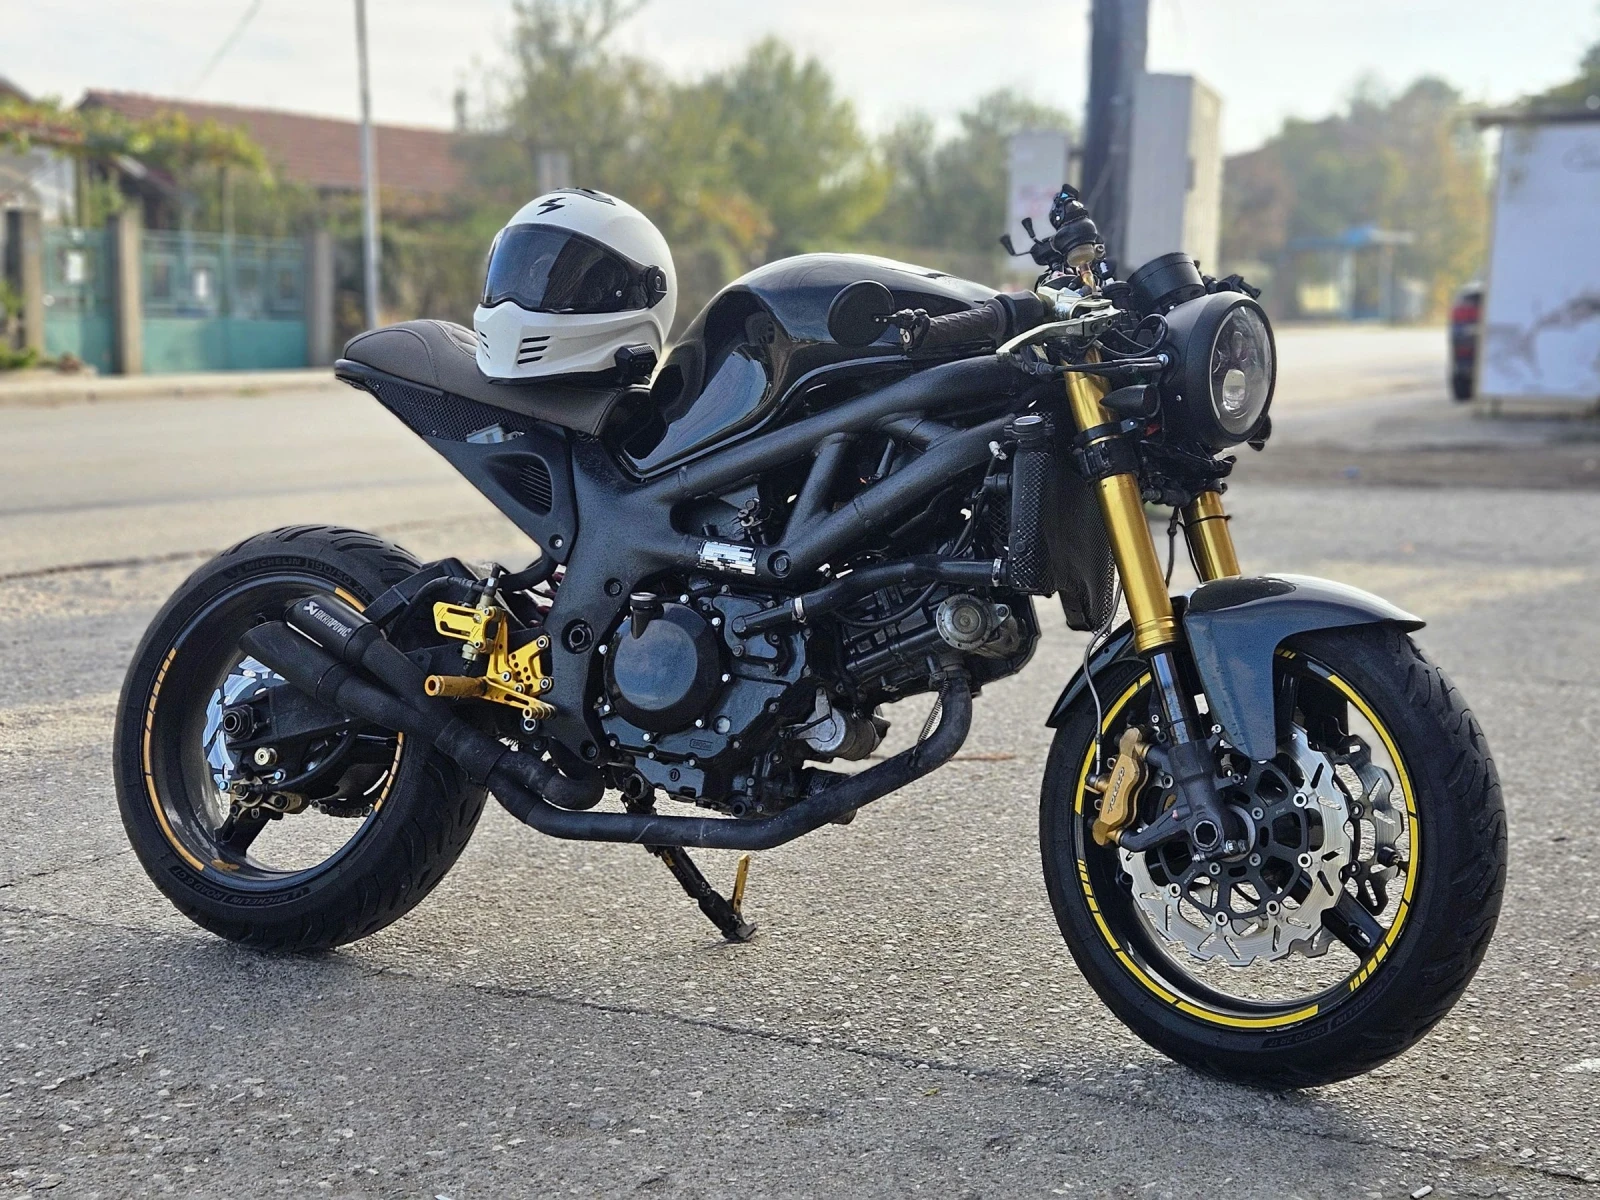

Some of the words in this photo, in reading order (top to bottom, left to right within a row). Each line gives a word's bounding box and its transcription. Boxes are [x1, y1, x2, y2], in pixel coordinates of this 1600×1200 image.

[244, 558, 302, 570] MICHELIN
[310, 561, 351, 585] 190/50
[172, 866, 186, 878] GT
[194, 883, 223, 900] ROAD
[230, 894, 289, 905] MICHELIN
[1295, 1026, 1326, 1041] 120/70
